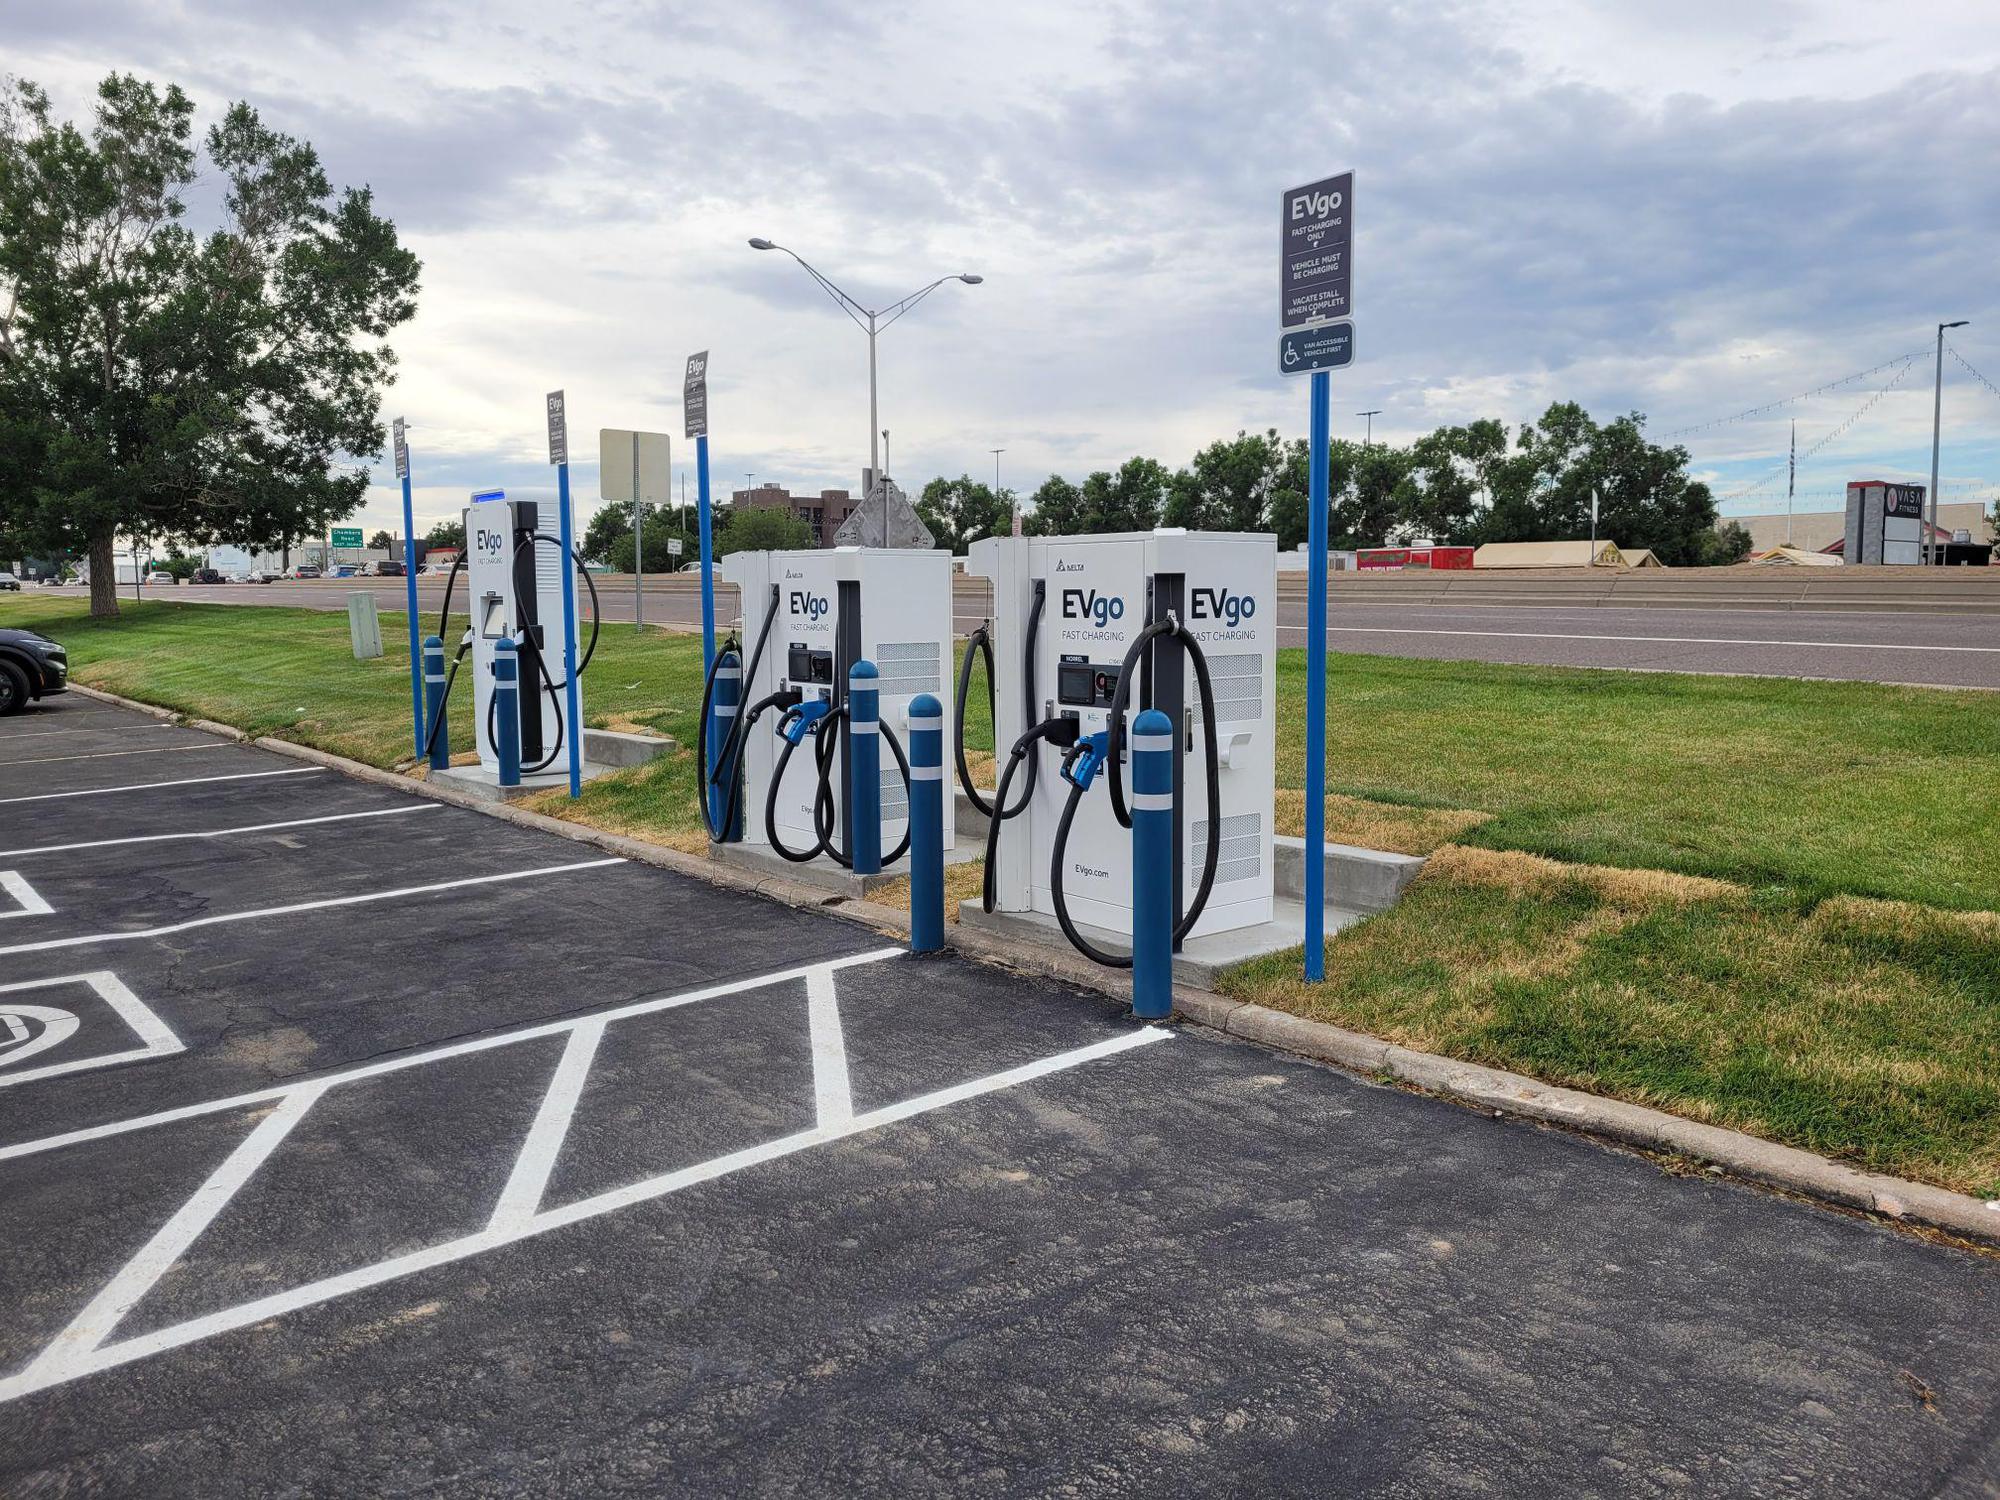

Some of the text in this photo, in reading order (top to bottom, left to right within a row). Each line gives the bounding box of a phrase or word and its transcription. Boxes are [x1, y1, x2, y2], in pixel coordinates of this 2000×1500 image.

[1292, 191, 1342, 220] EVgo
[1291, 217, 1342, 237] FAST CHARGING
[1307, 231, 1325, 242] ONLY
[1291, 253, 1341, 271] VEHICLE MUST
[1293, 263, 1339, 280] BE CHARGING
[1292, 289, 1339, 306] VACATE STALL
[1287, 297, 1344, 316] WHEN COMPLETE
[1316, 336, 1349, 347] ACCESSIBLE
[1304, 345, 1342, 357] VEHICLE FIRST
[688, 359, 704, 375] EVgo
[549, 397, 562, 411] EVgo
[1898, 490, 1920, 503] VASA
[1899, 505, 1919, 513] FITNESS
[477, 529, 502, 555] EVgo
[790, 591, 828, 621] EVgo
[1063, 589, 1124, 628] EVgo
[1191, 588, 1256, 628] EVgo
[790, 623, 829, 632] FAST CHARGING
[1062, 630, 1125, 641] FAST CHARGING
[1212, 630, 1256, 641] CHARGING
[1075, 864, 1109, 878] EVgo.com
